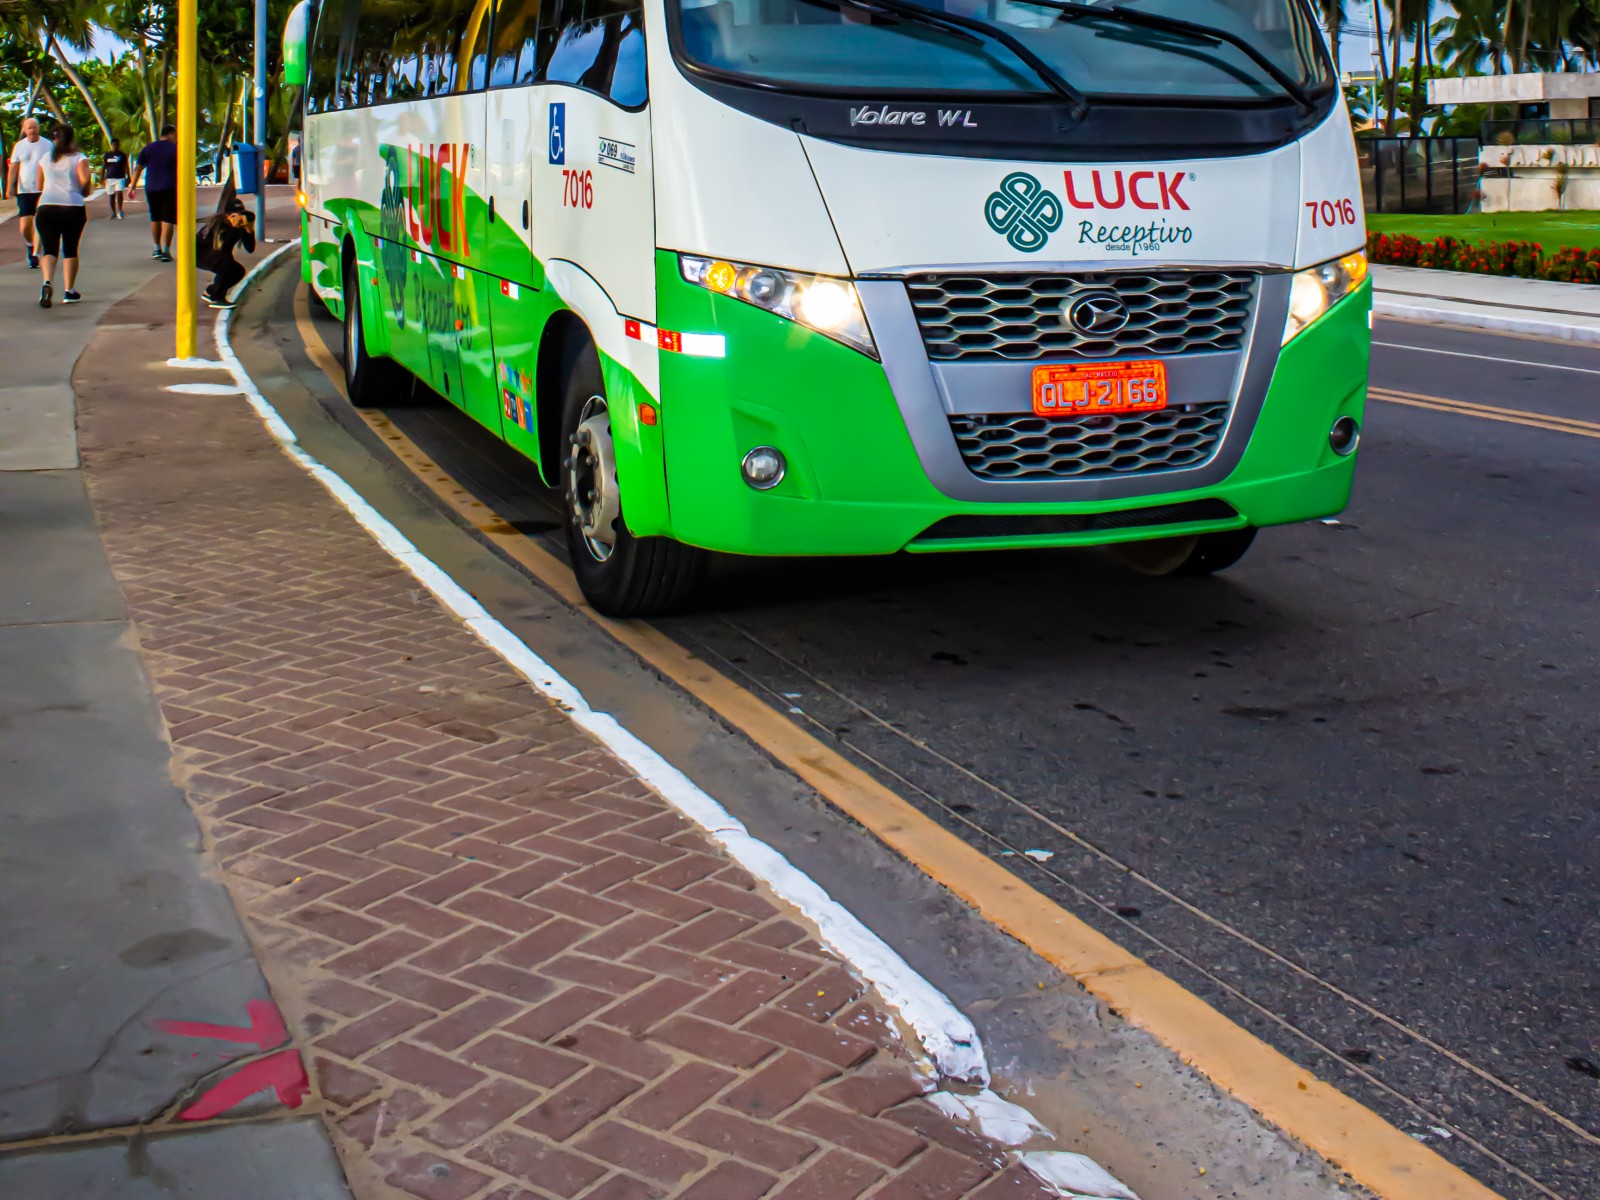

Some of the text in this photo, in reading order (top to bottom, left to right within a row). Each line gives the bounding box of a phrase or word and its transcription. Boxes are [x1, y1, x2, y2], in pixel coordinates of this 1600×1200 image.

[850, 104, 927, 127] Volare
[408, 143, 471, 258] LUCK
[562, 169, 593, 209] 7016
[1063, 170, 1191, 210] LUCK
[1305, 198, 1356, 229] 7016
[1078, 217, 1193, 256] Receptivo
[1105, 242, 1161, 251] desde 1960
